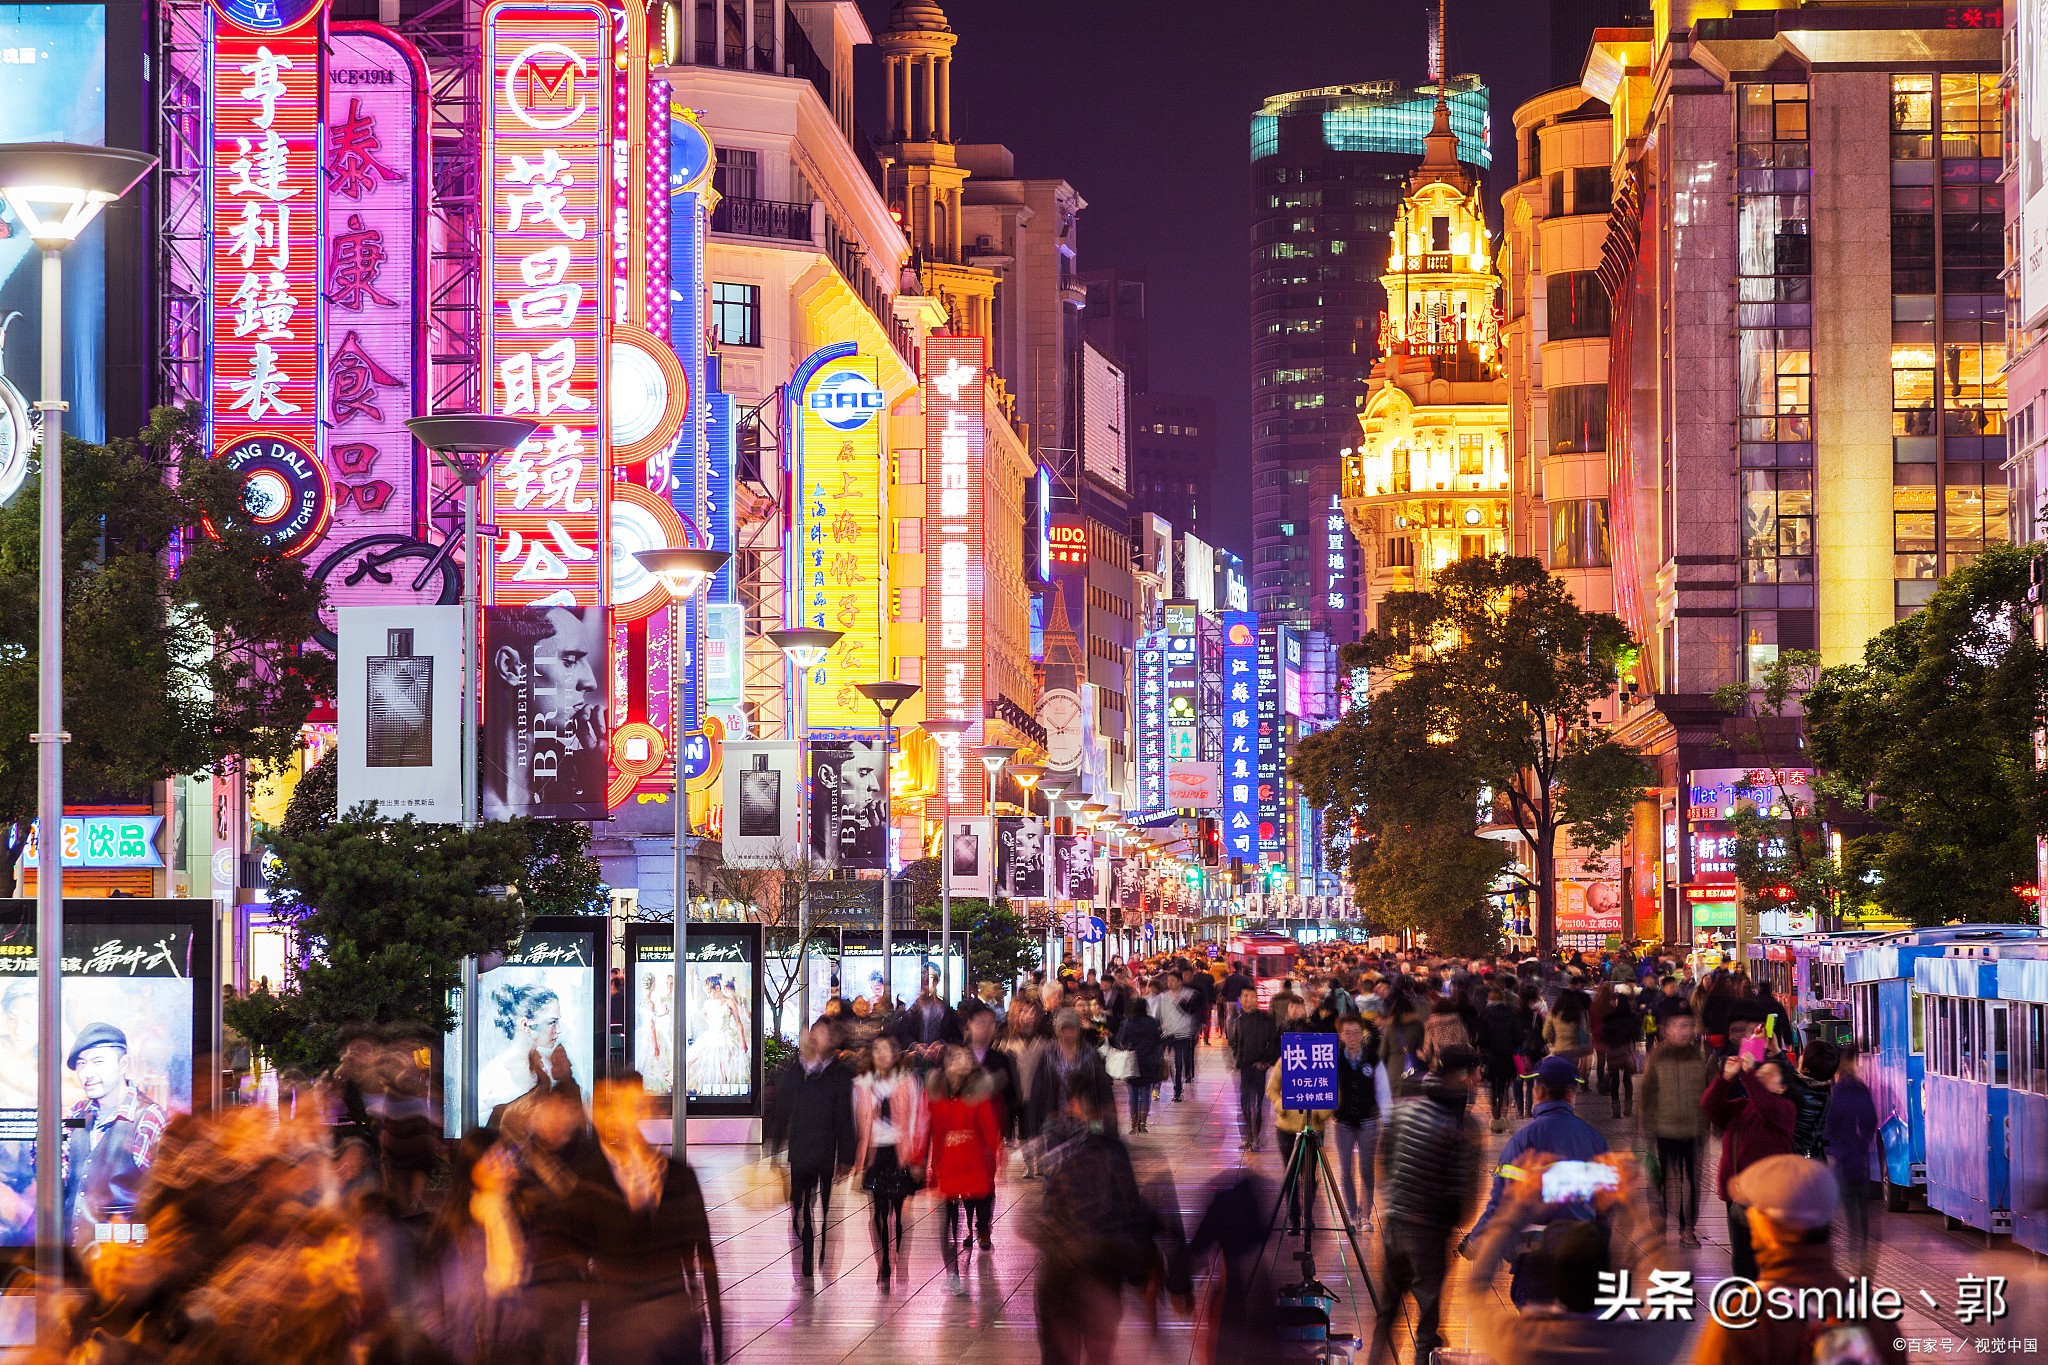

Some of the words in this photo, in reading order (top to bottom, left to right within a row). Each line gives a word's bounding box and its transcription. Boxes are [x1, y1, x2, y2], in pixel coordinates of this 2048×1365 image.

[810, 392, 884, 409] BAC
[270, 443, 313, 480] DALI
[518, 661, 528, 767] BURBERRY
[533, 644, 558, 782] BRIT
[831, 774, 839, 838] BURBERRY
[840, 763, 856, 847] BRIT
[87, 824, 146, 858] 饮品
[1706, 889, 1737, 898] RESTAURA
[0, 957, 83, 973] 实力派画家
[1283, 1043, 1336, 1071] 快照
[1286, 1091, 1334, 1102] 一分钟成相
[1291, 1077, 1329, 1088] 10元/张
